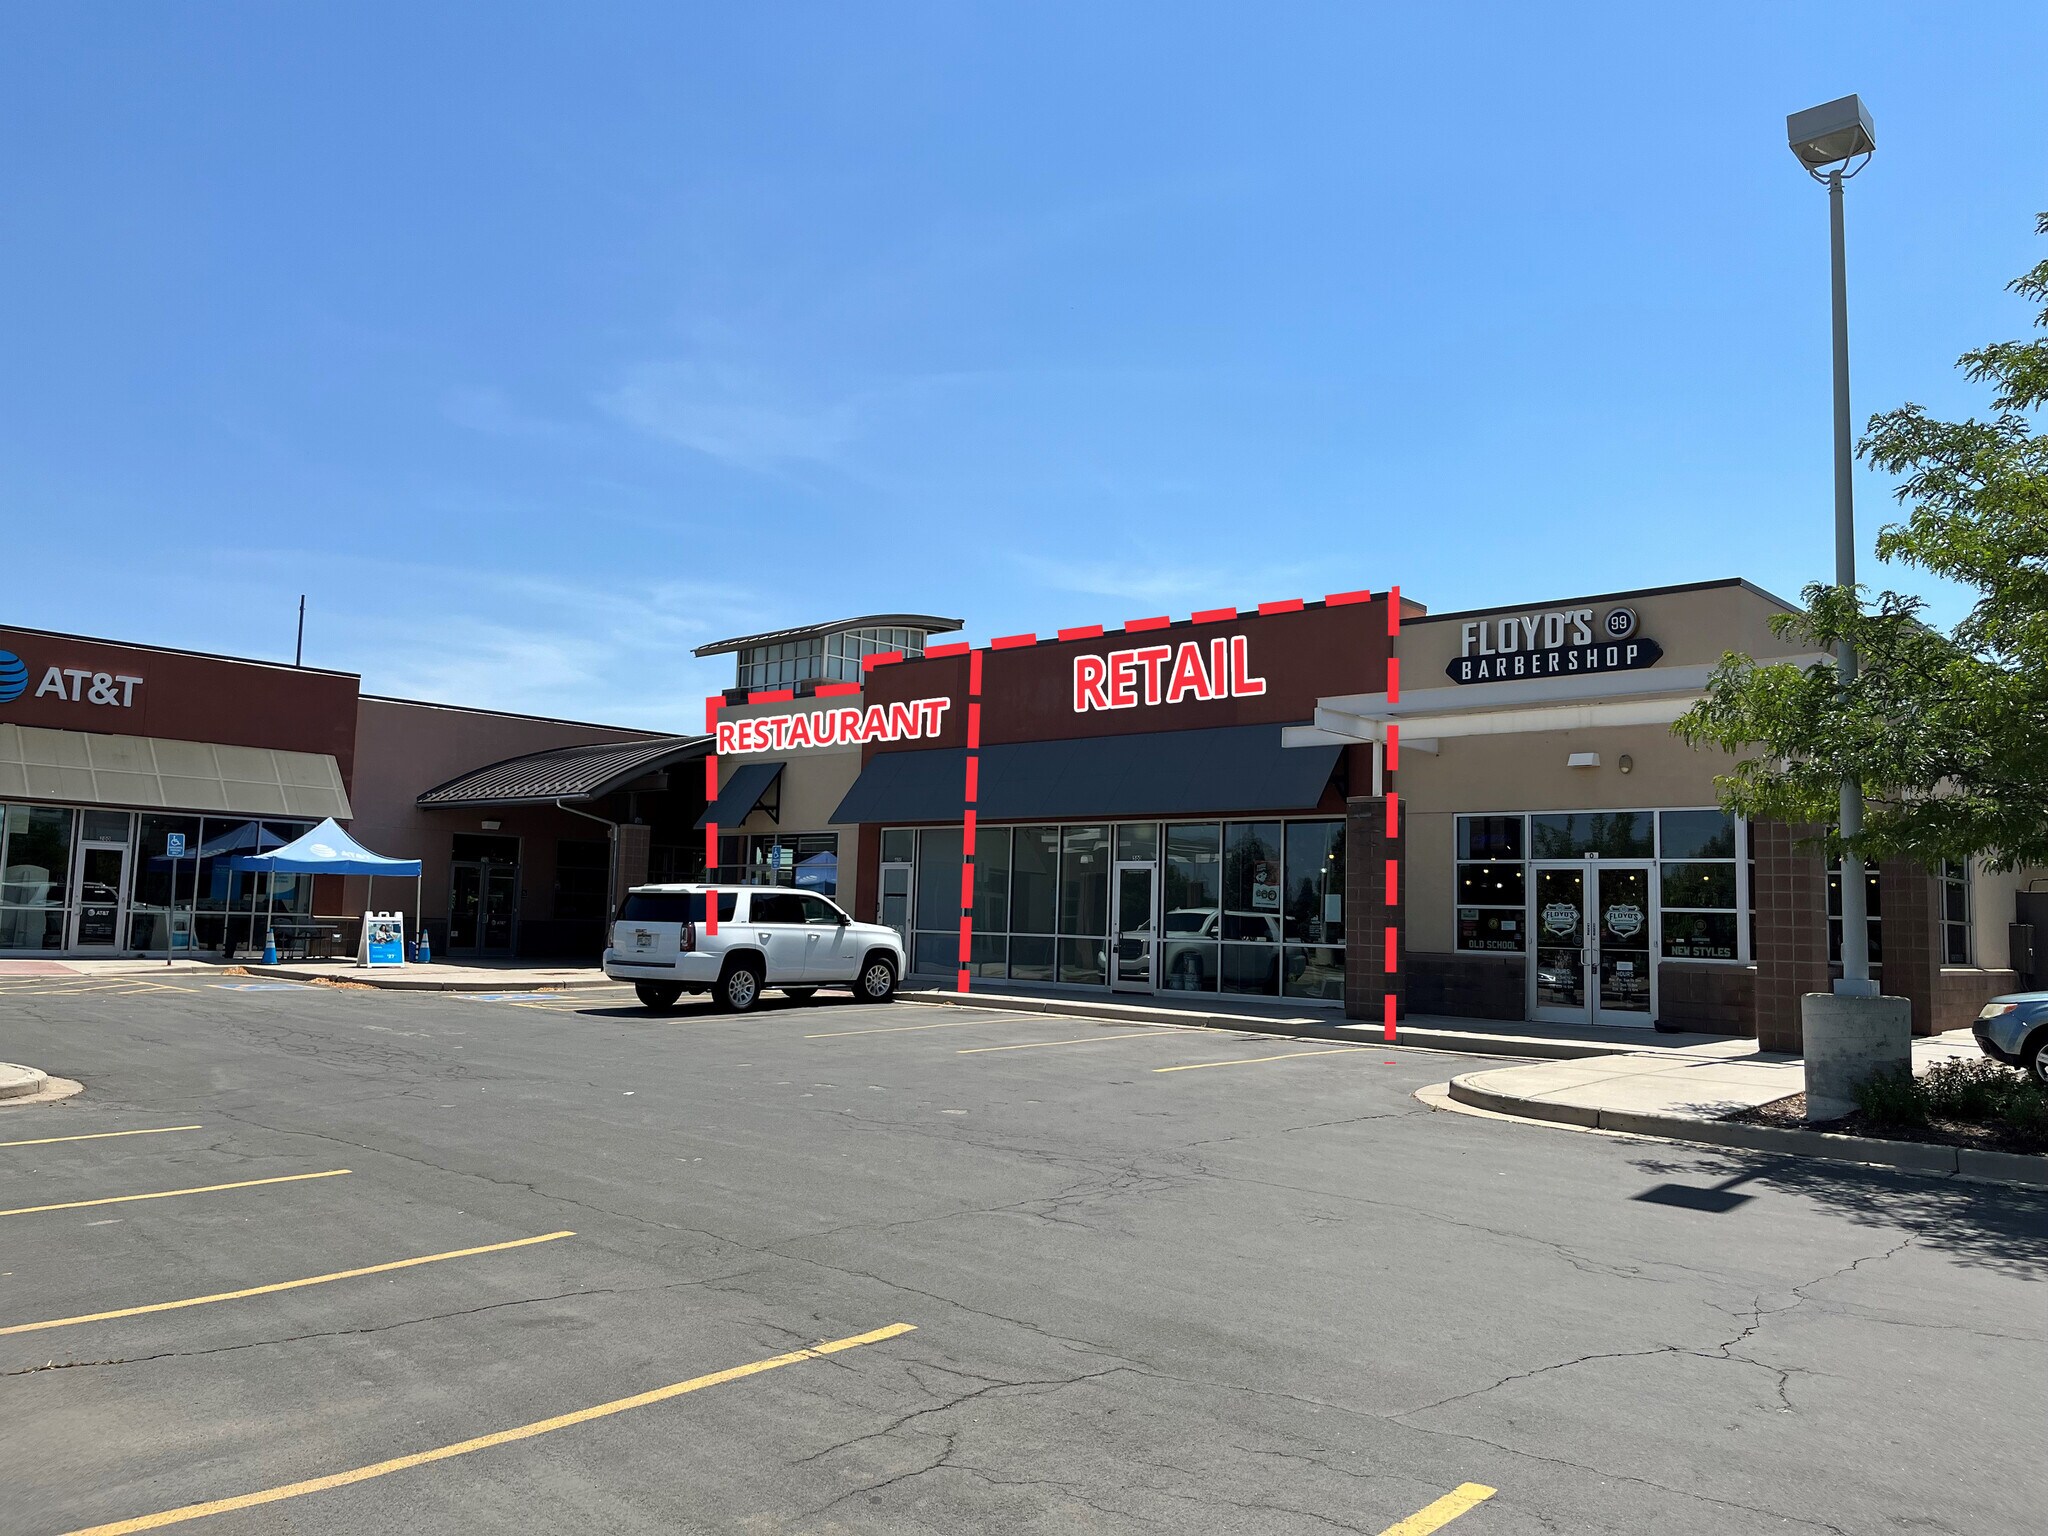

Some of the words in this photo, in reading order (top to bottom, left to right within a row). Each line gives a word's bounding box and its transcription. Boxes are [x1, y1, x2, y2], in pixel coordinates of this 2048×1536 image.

[1462, 608, 1593, 657] FLOYD'S
[1611, 615, 1628, 631] 99
[1461, 644, 1638, 680] BARBERSHOP
[34, 666, 144, 708] AT&T
[1546, 911, 1575, 919] FLOYD'S
[1609, 912, 1638, 921] FLOYD'S
[1469, 940, 1485, 948] OLD
[1487, 940, 1518, 950] SCHOOL
[1671, 946, 1690, 956] NEW
[1693, 946, 1731, 957] STYLES
[1615, 970, 1634, 978] HOURS
